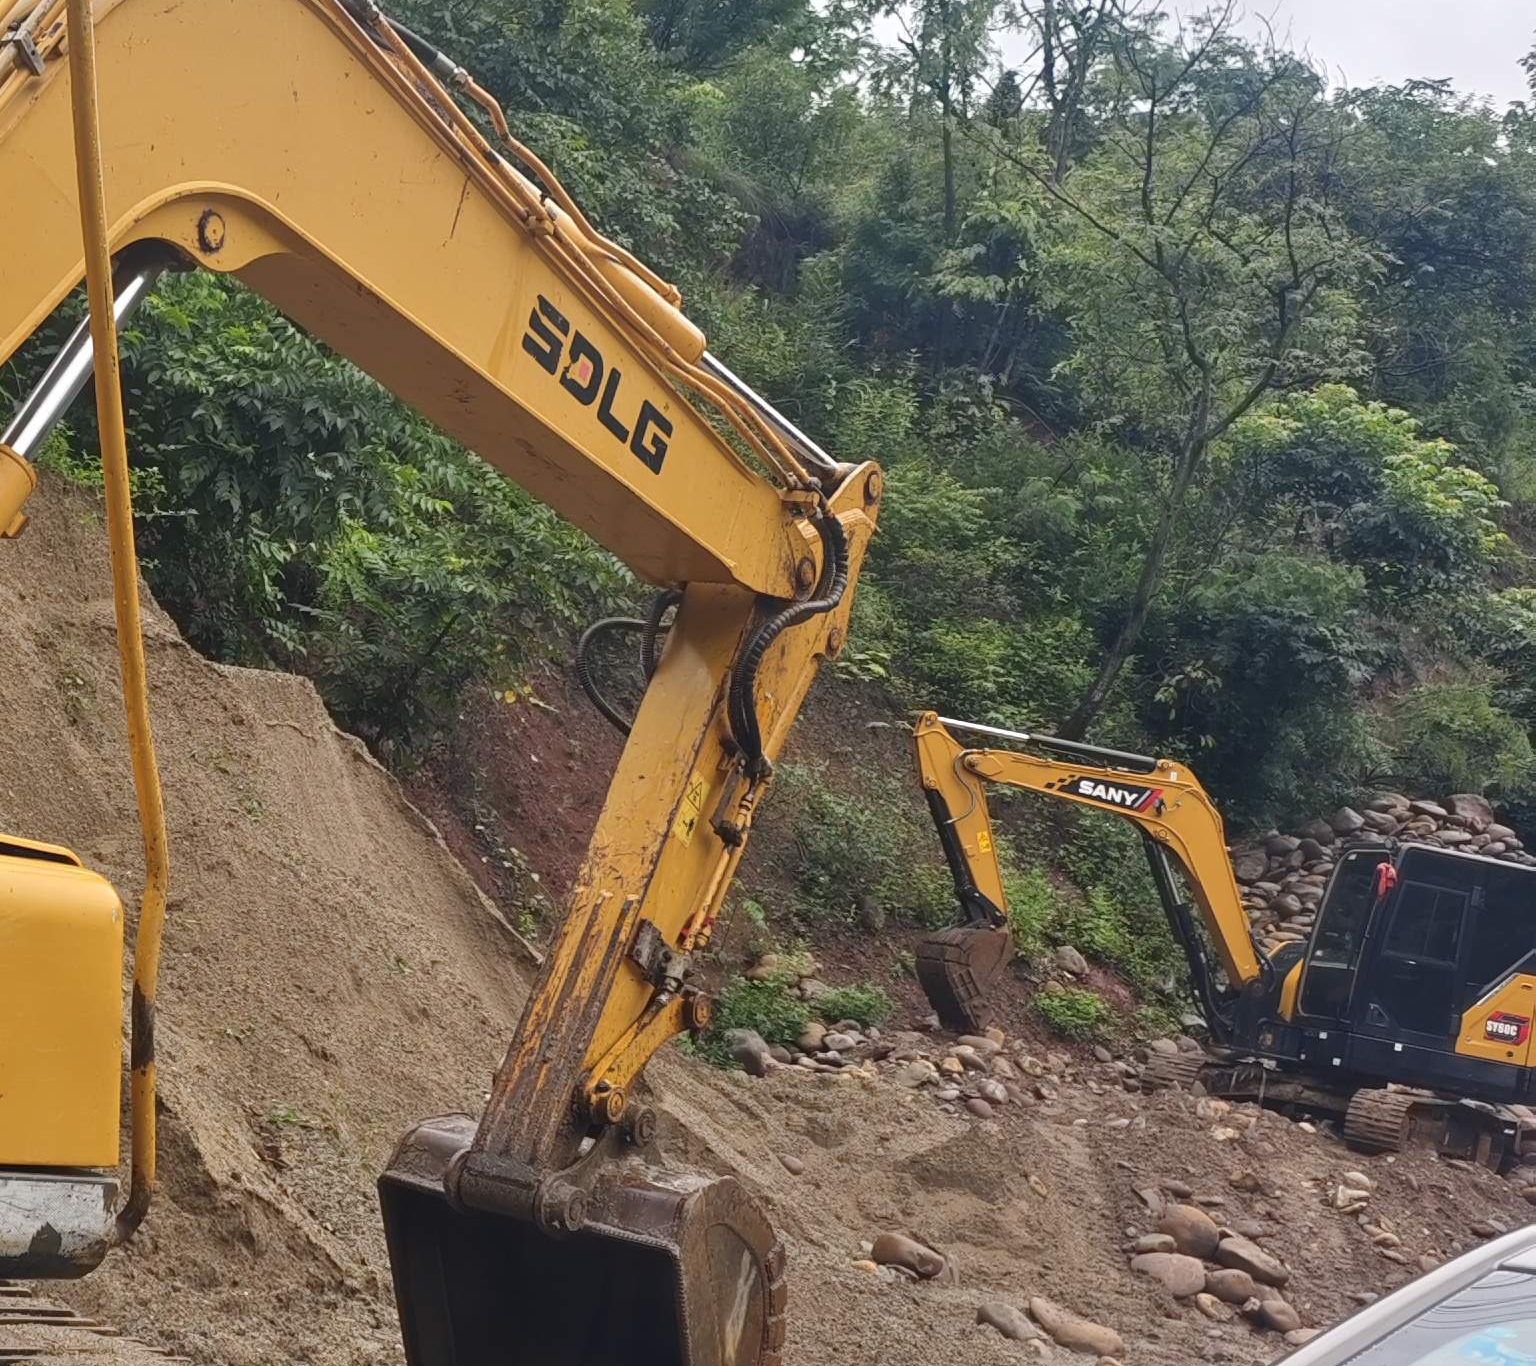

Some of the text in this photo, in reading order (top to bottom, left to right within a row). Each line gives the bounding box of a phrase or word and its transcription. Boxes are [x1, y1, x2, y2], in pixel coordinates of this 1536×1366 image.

[521, 294, 674, 476] SDLG
[1078, 779, 1139, 806] SANY
[1486, 1020, 1518, 1036] SY60C
